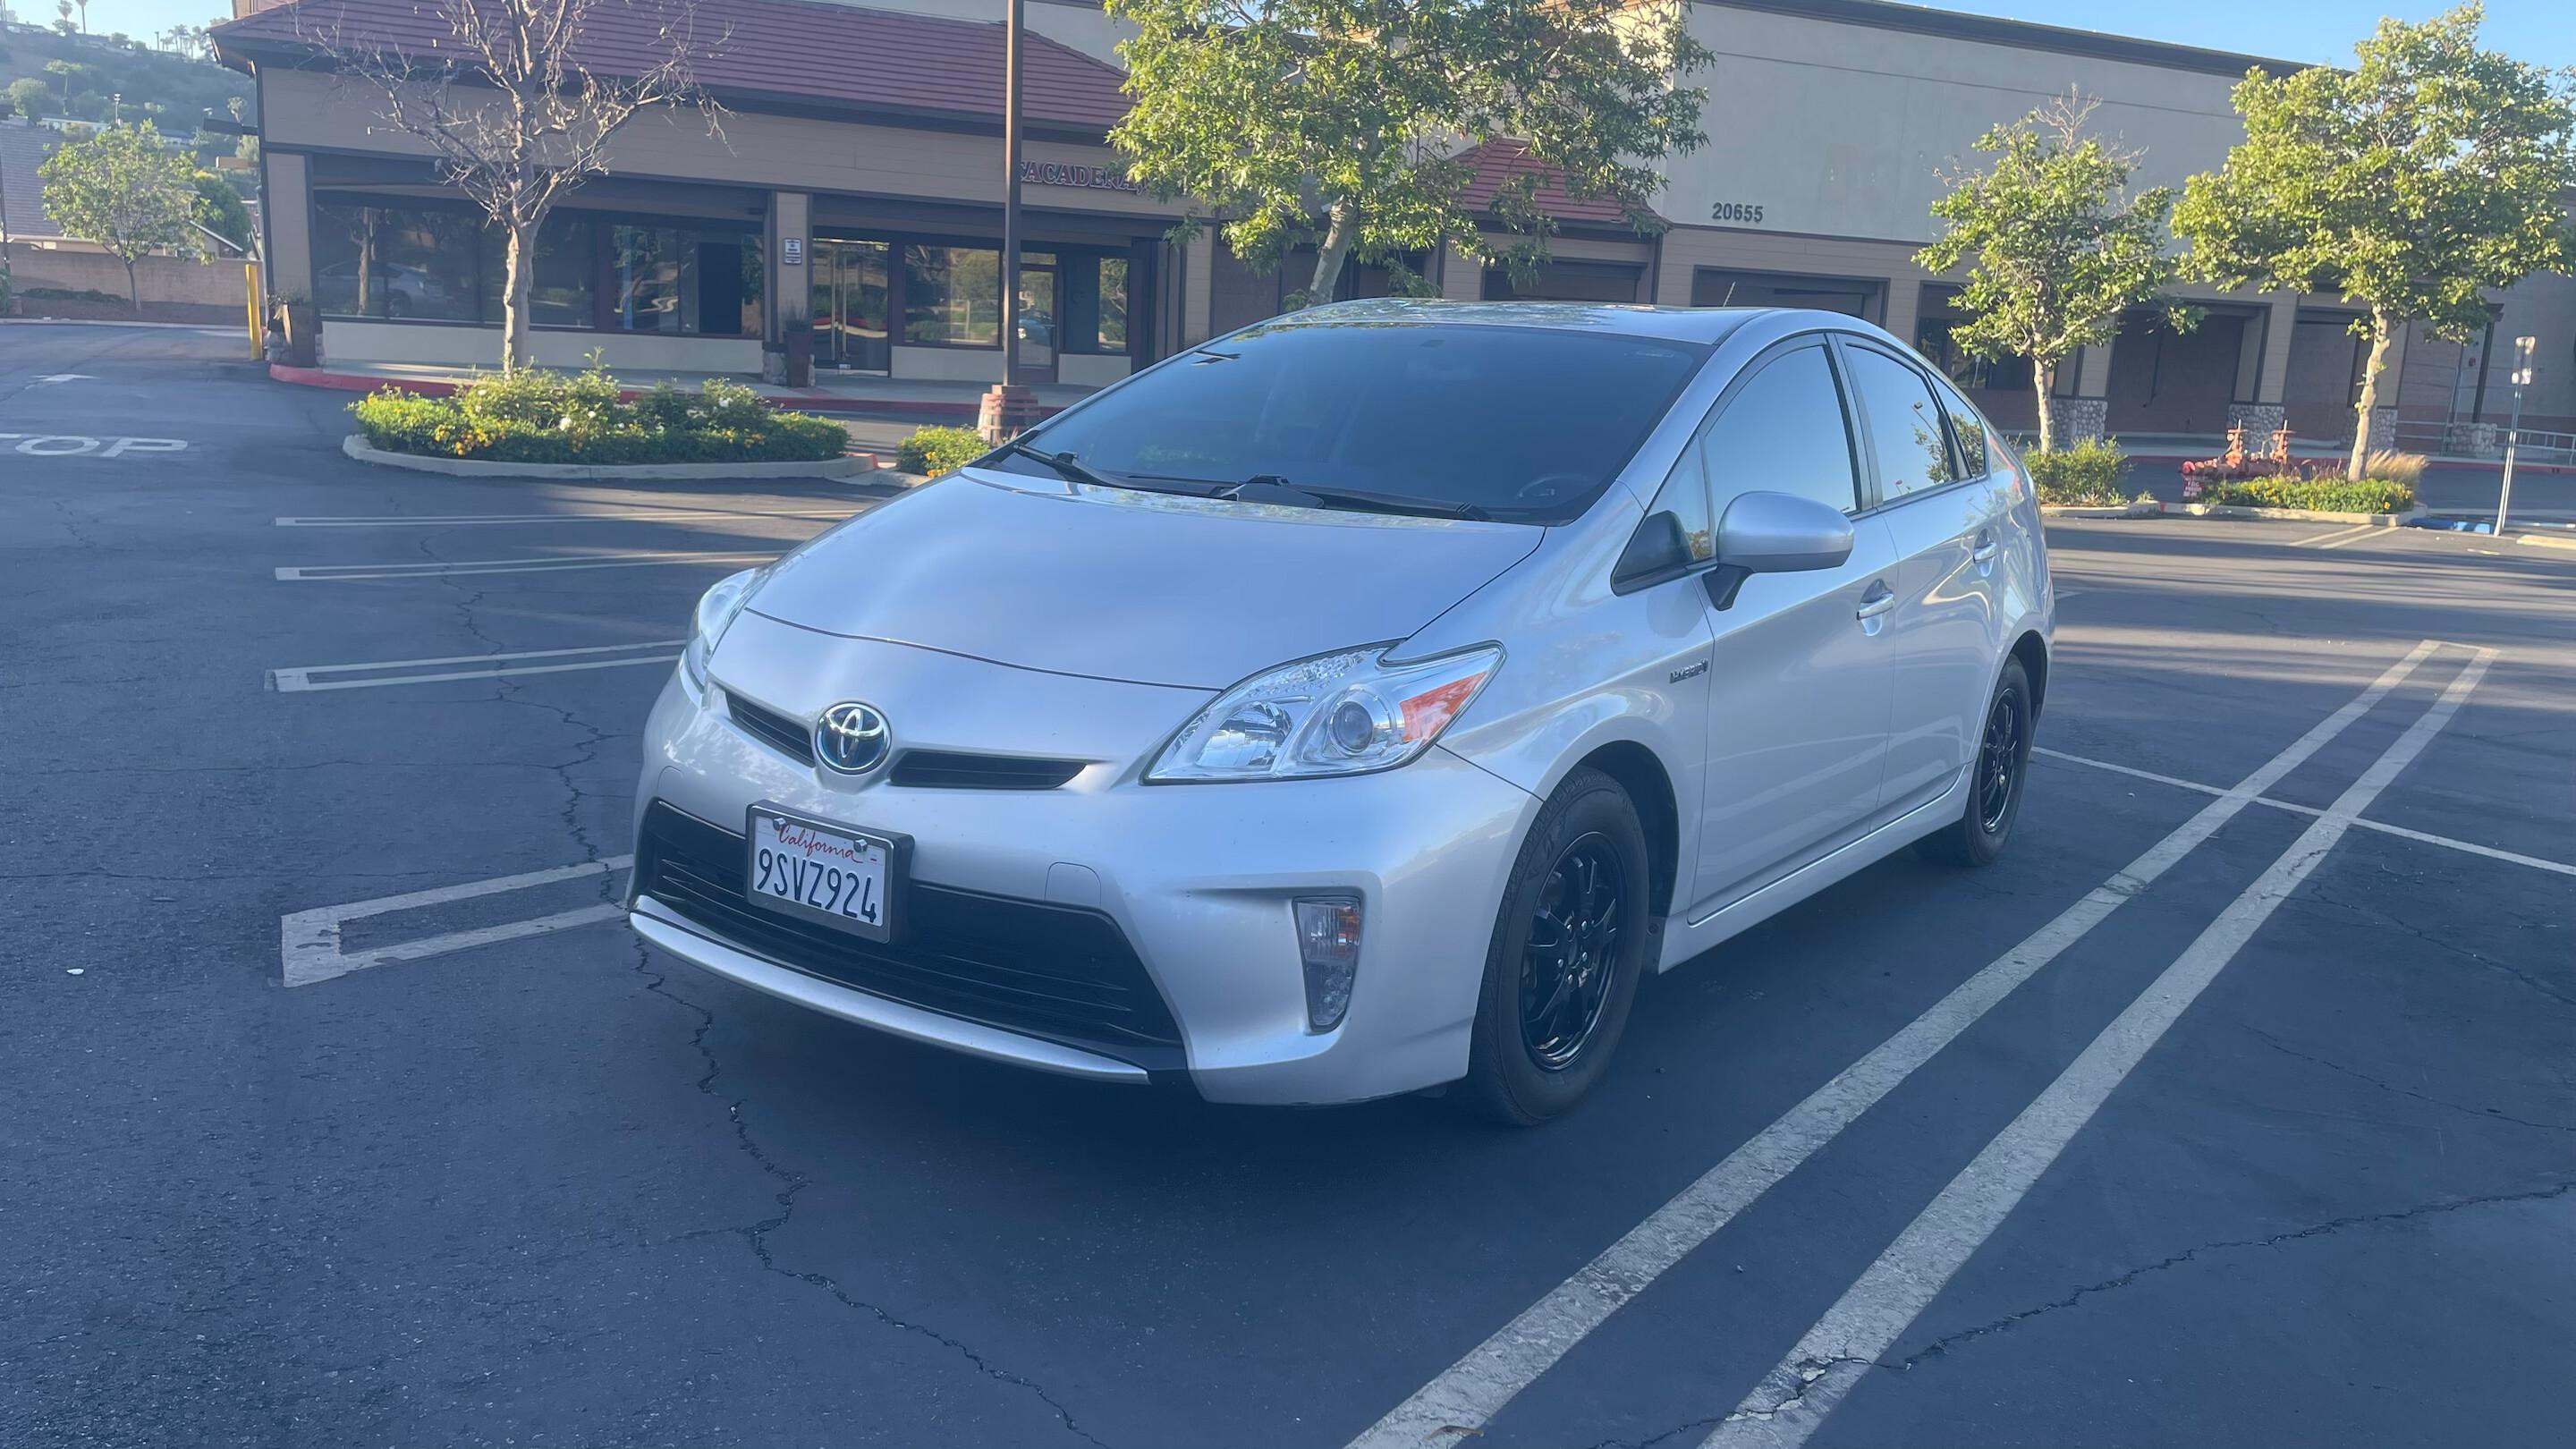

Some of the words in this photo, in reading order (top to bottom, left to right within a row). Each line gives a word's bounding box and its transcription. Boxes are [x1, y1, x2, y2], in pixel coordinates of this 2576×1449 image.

[1711, 202, 1764, 223] 20655
[779, 824, 864, 864] California
[757, 848, 877, 923] 9SVZ924
